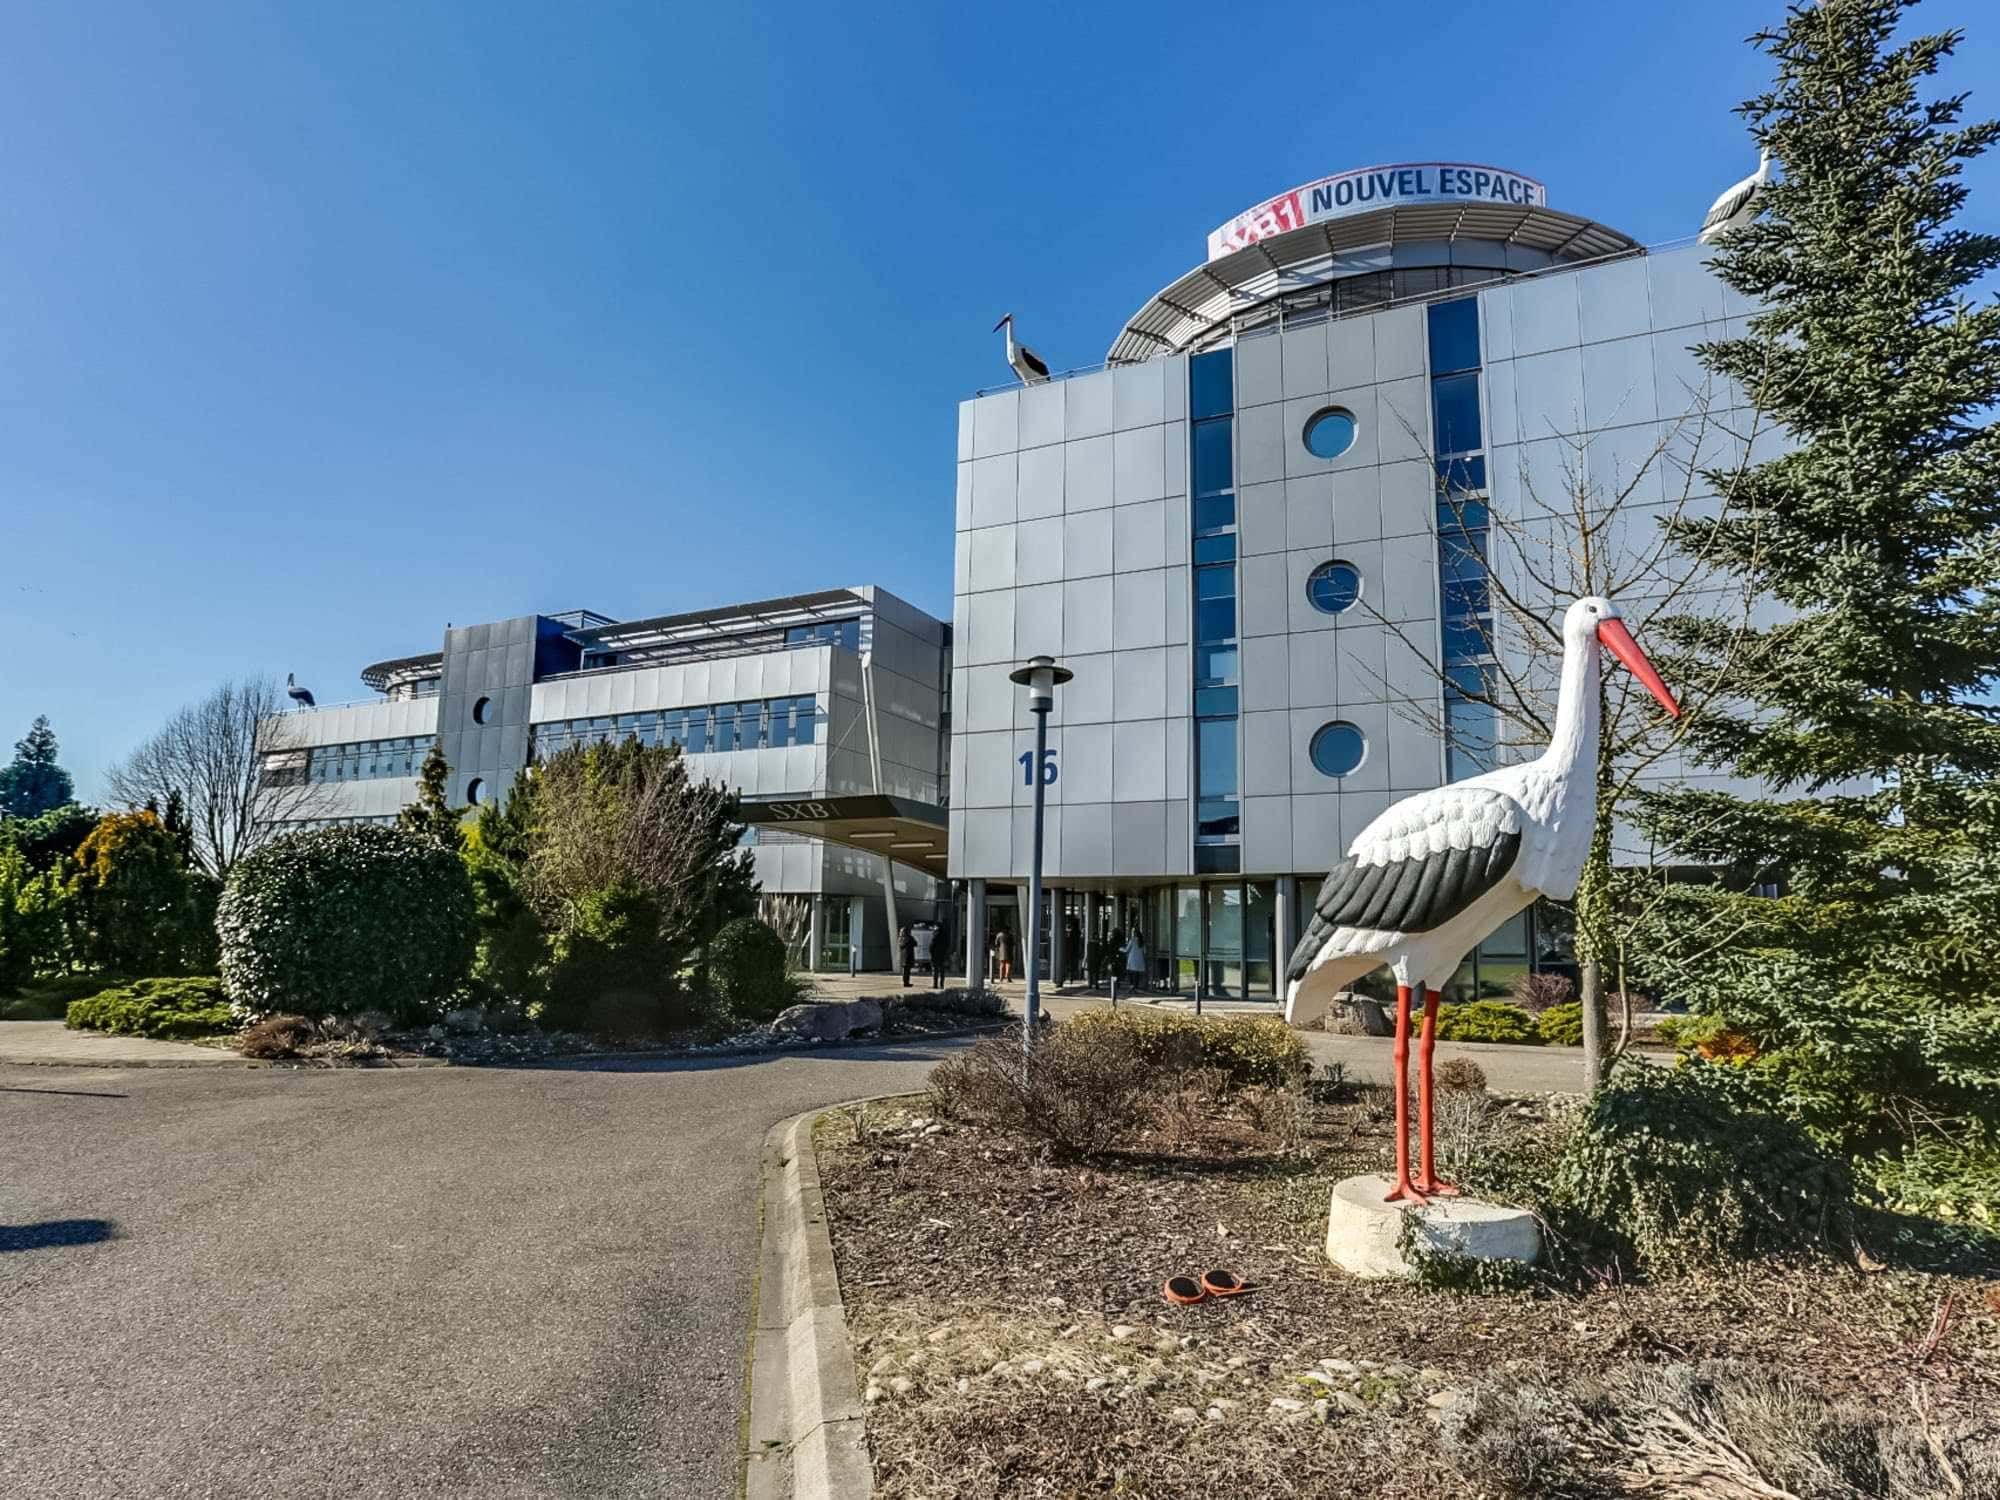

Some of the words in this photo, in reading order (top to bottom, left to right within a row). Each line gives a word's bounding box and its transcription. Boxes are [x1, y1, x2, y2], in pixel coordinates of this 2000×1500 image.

[1312, 170, 1431, 213] NOUVEL
[1440, 168, 1535, 204] ESPACE
[1018, 749, 1058, 785] 16
